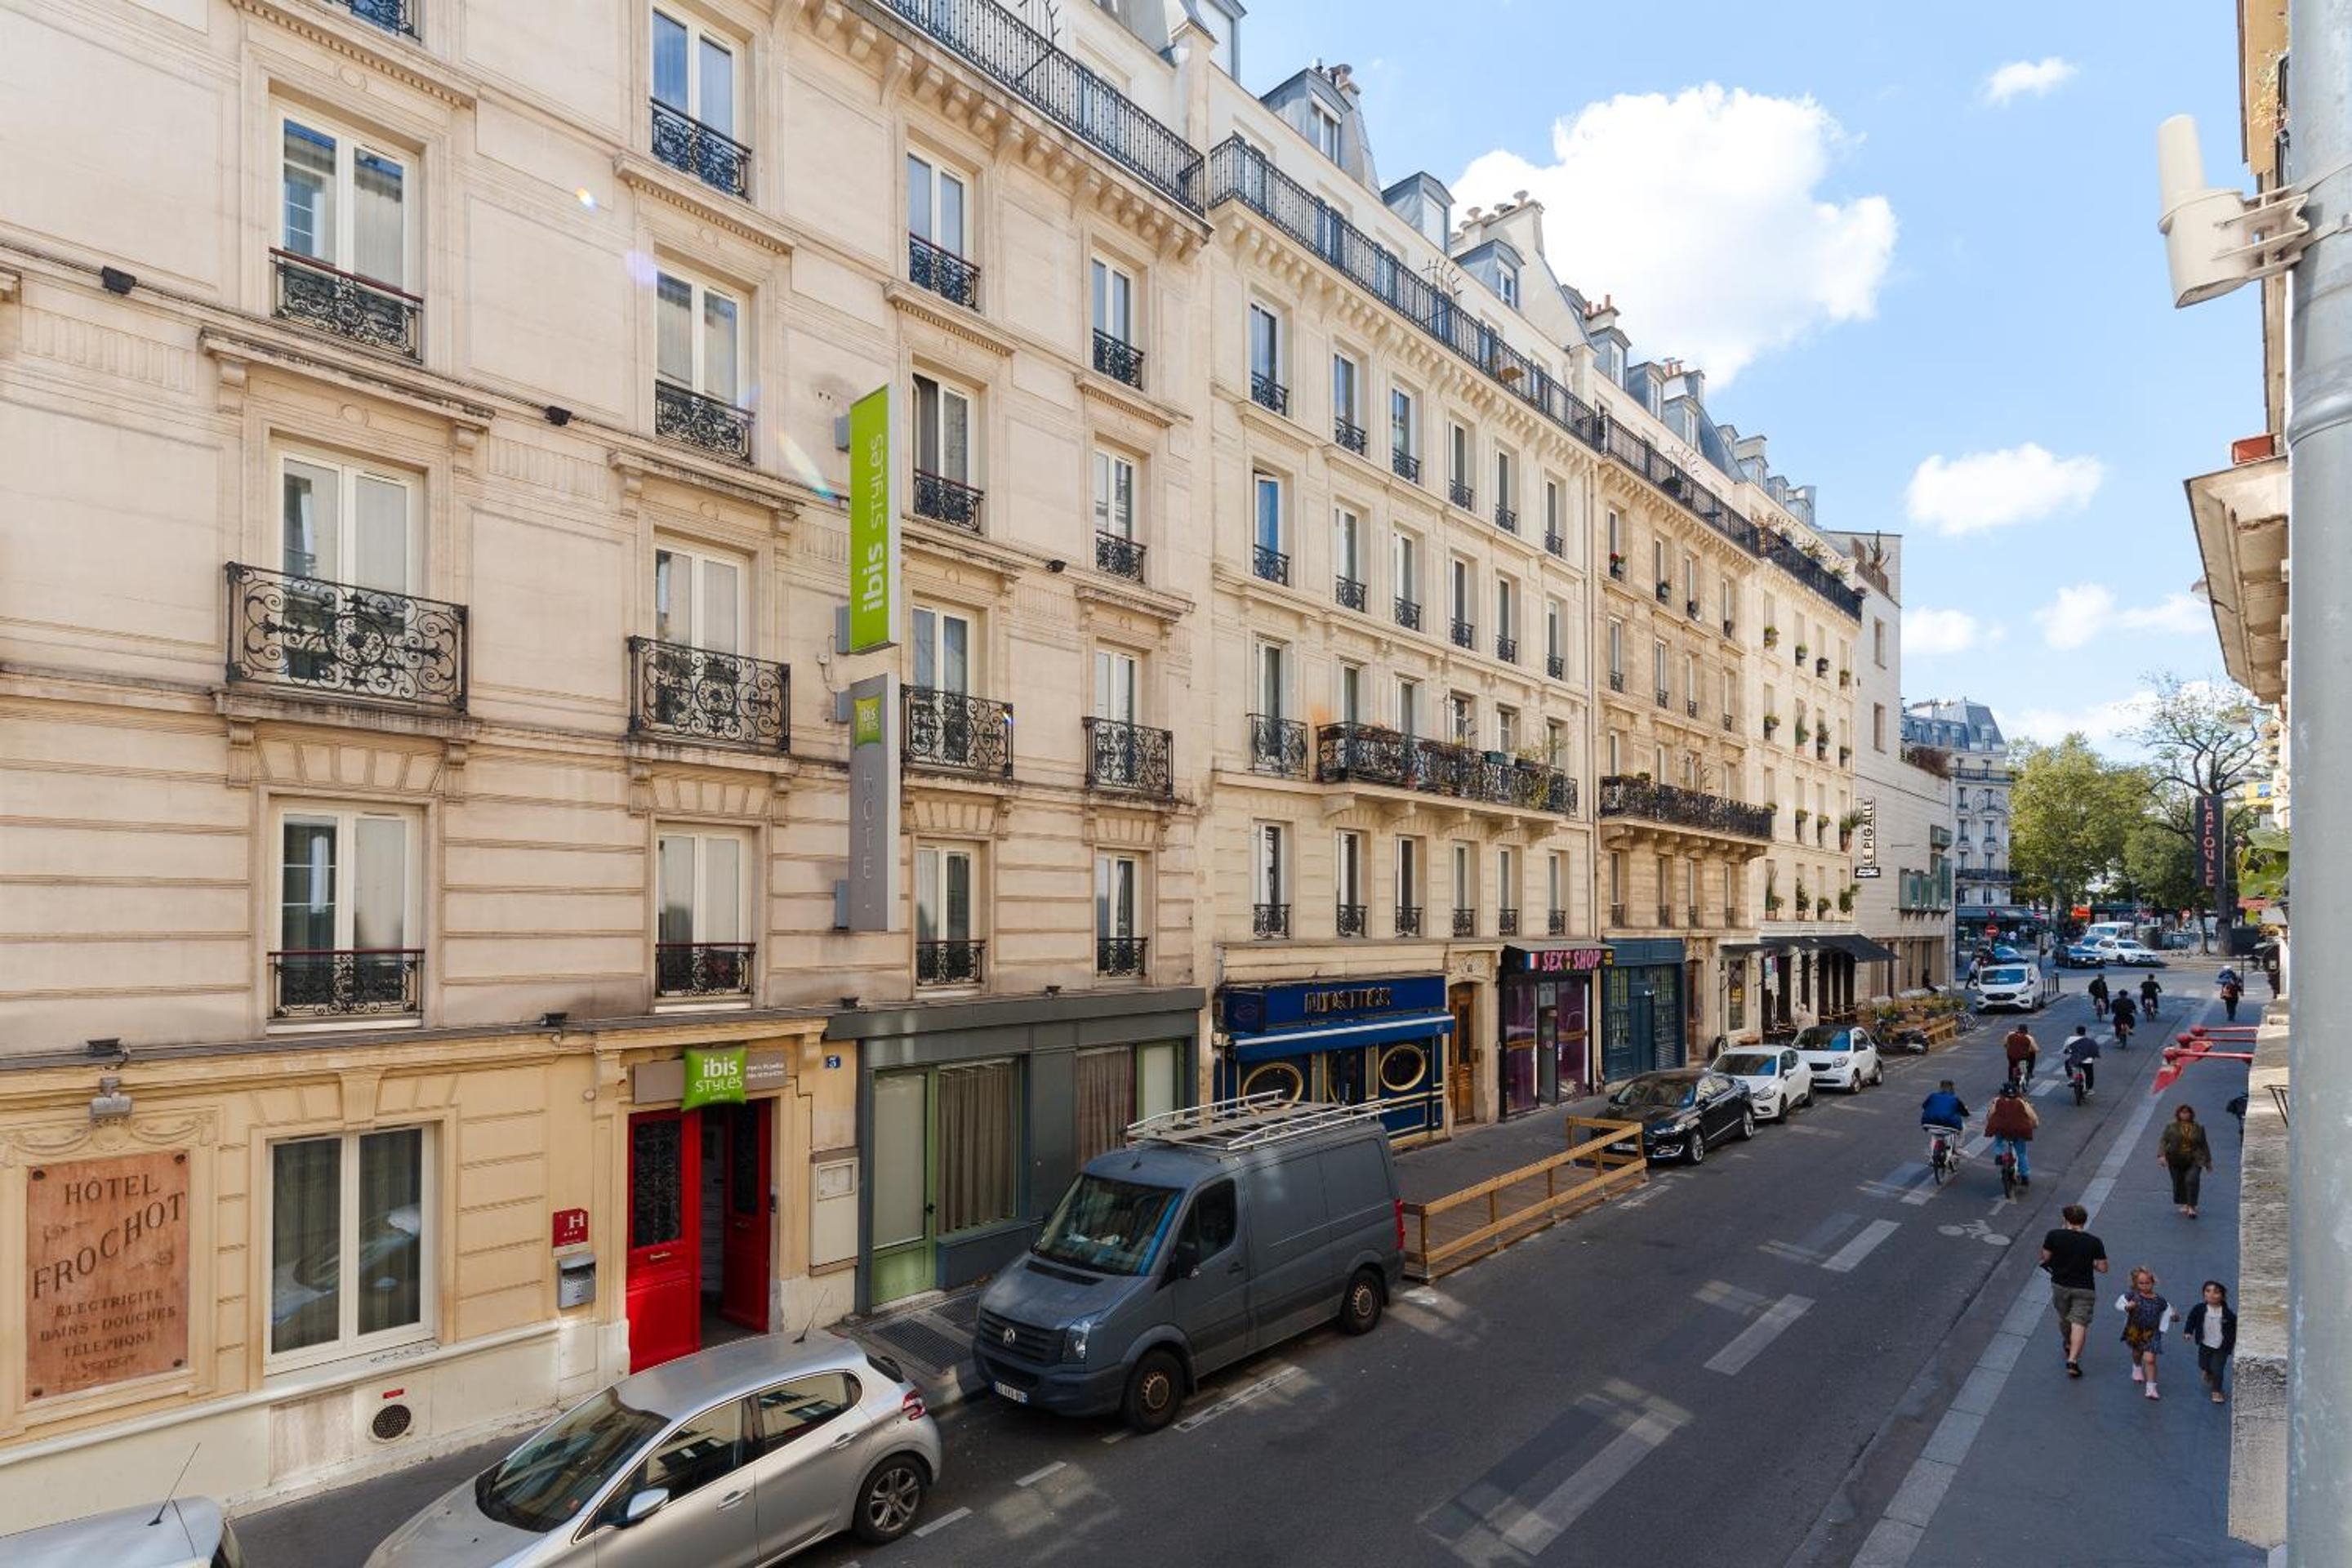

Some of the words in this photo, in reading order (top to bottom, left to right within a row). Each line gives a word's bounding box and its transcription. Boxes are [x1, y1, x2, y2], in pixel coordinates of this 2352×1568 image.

[863, 542, 884, 612] ibis
[1864, 799, 1873, 849] PIGALLE
[862, 769, 874, 909] HOTE
[1864, 853, 1873, 866] LE
[1542, 951, 1563, 971] SEX
[1573, 950, 1601, 969] SHOP
[703, 1057, 738, 1077] ibis
[65, 1174, 161, 1205] HÔTEL
[568, 1212, 585, 1228] H
[33, 1192, 186, 1300] FROCHOT
[101, 1307, 176, 1331] DOUCHES
